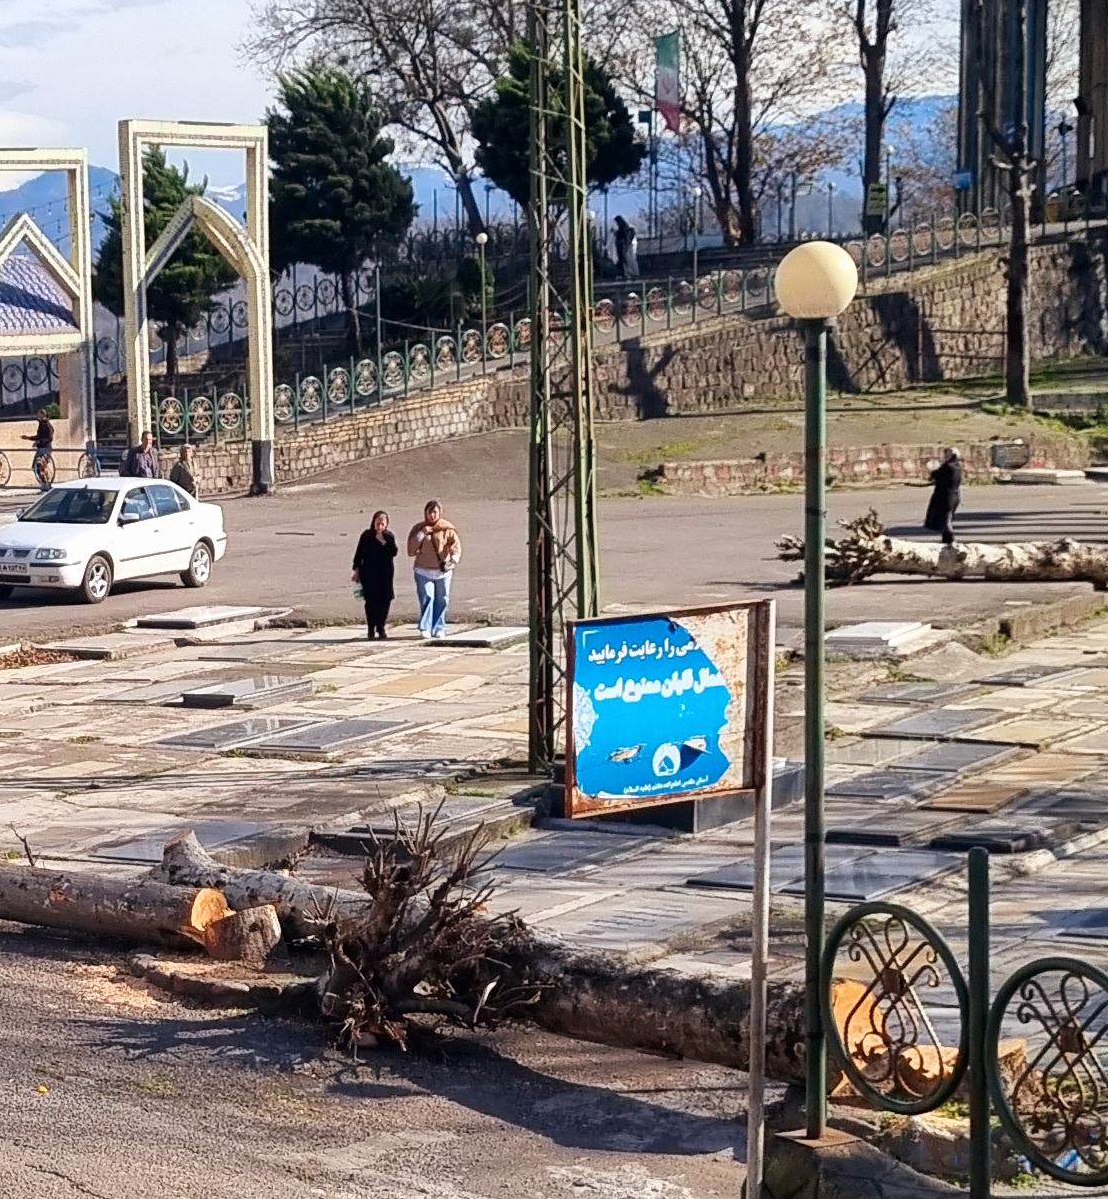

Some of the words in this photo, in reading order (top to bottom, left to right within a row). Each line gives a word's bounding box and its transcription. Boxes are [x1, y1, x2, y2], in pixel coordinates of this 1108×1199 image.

[588, 641, 628, 664] فرمایید
[629, 639, 663, 660] رعایت
[664, 637, 675, 659] را
[594, 676, 624, 701] است
[622, 677, 662, 702] ممنوع
